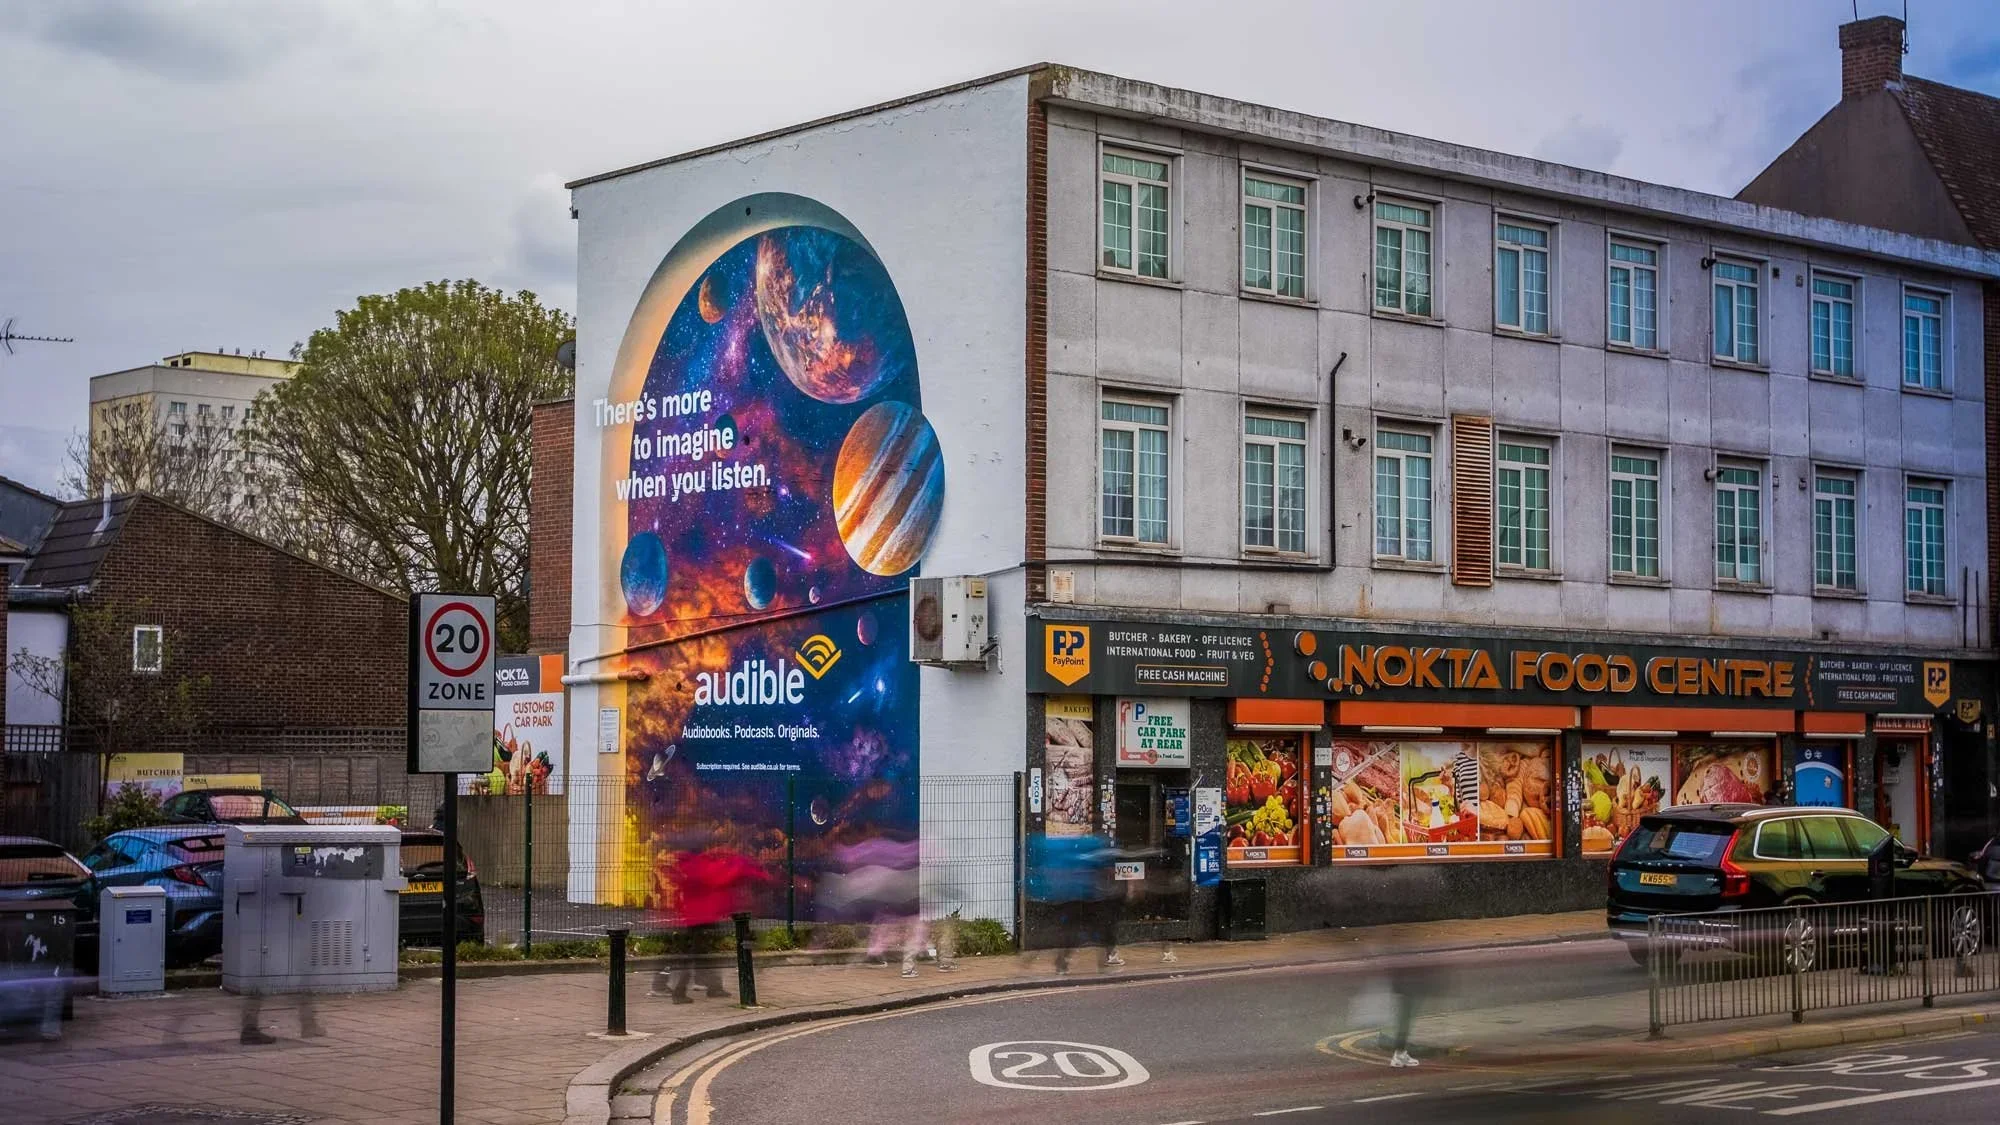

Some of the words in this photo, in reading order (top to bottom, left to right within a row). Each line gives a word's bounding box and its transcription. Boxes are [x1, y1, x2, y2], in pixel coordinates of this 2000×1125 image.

[593, 392, 657, 427] There's
[662, 389, 712, 418] more
[633, 434, 651, 460] to
[656, 423, 734, 461] imagine
[616, 470, 666, 501] when
[671, 469, 706, 502] you
[711, 461, 771, 491] listen.
[435, 623, 480, 653] 20
[1109, 631, 1148, 643] BUTCHER
[1158, 633, 1191, 645] BAKERY
[1202, 634, 1218, 645] OFF
[1219, 635, 1252, 647] LICENCE
[1106, 646, 1173, 658] INTERNATIONAL
[1174, 648, 1196, 659] FOOD
[1206, 649, 1230, 660] FRUIT
[1231, 650, 1238, 660] &
[1239, 650, 1255, 661] VEG
[1052, 657, 1085, 667] PayPoint
[1820, 660, 1845, 669] BUTCHER
[1852, 662, 1873, 670] BAKERY
[1880, 663, 1889, 671] OFF
[1890, 664, 1913, 672] LICENCE
[496, 668, 529, 681] NOKTA
[1138, 669, 1161, 680] FREE
[1162, 670, 1185, 681] CASH
[1186, 671, 1226, 682] MACHINE
[1339, 644, 1503, 689] NOKTA
[1511, 650, 1638, 693] FOOD
[1645, 656, 1796, 697] CENTRE
[694, 658, 805, 706] audible
[1818, 672, 1862, 681] INTERNATIONAL
[1862, 674, 1876, 682] FOOD
[1882, 674, 1898, 683] FRUIT
[428, 682, 485, 701] ZONE
[1838, 690, 1853, 699] FREE
[1854, 691, 1869, 700] CASH
[1869, 691, 1896, 701] MACHINE
[512, 701, 555, 714] CUSTOMER
[1063, 705, 1091, 714] BAKERY
[1135, 703, 1146, 720] P
[514, 716, 531, 727] CAR
[532, 715, 553, 727] PARK
[1147, 715, 1173, 726] FREE
[682, 725, 732, 739] Audiobooks.
[734, 724, 776, 739] Podcasts.
[777, 724, 820, 742] Originals.
[1137, 727, 1157, 737] CAR
[1159, 727, 1186, 738] PARK
[1140, 738, 1154, 748] AT
[1156, 739, 1183, 750] REAR
[136, 769, 181, 777] BUTCHERS
[52, 915, 66, 925] 15
[994, 1051, 1121, 1078] 20
